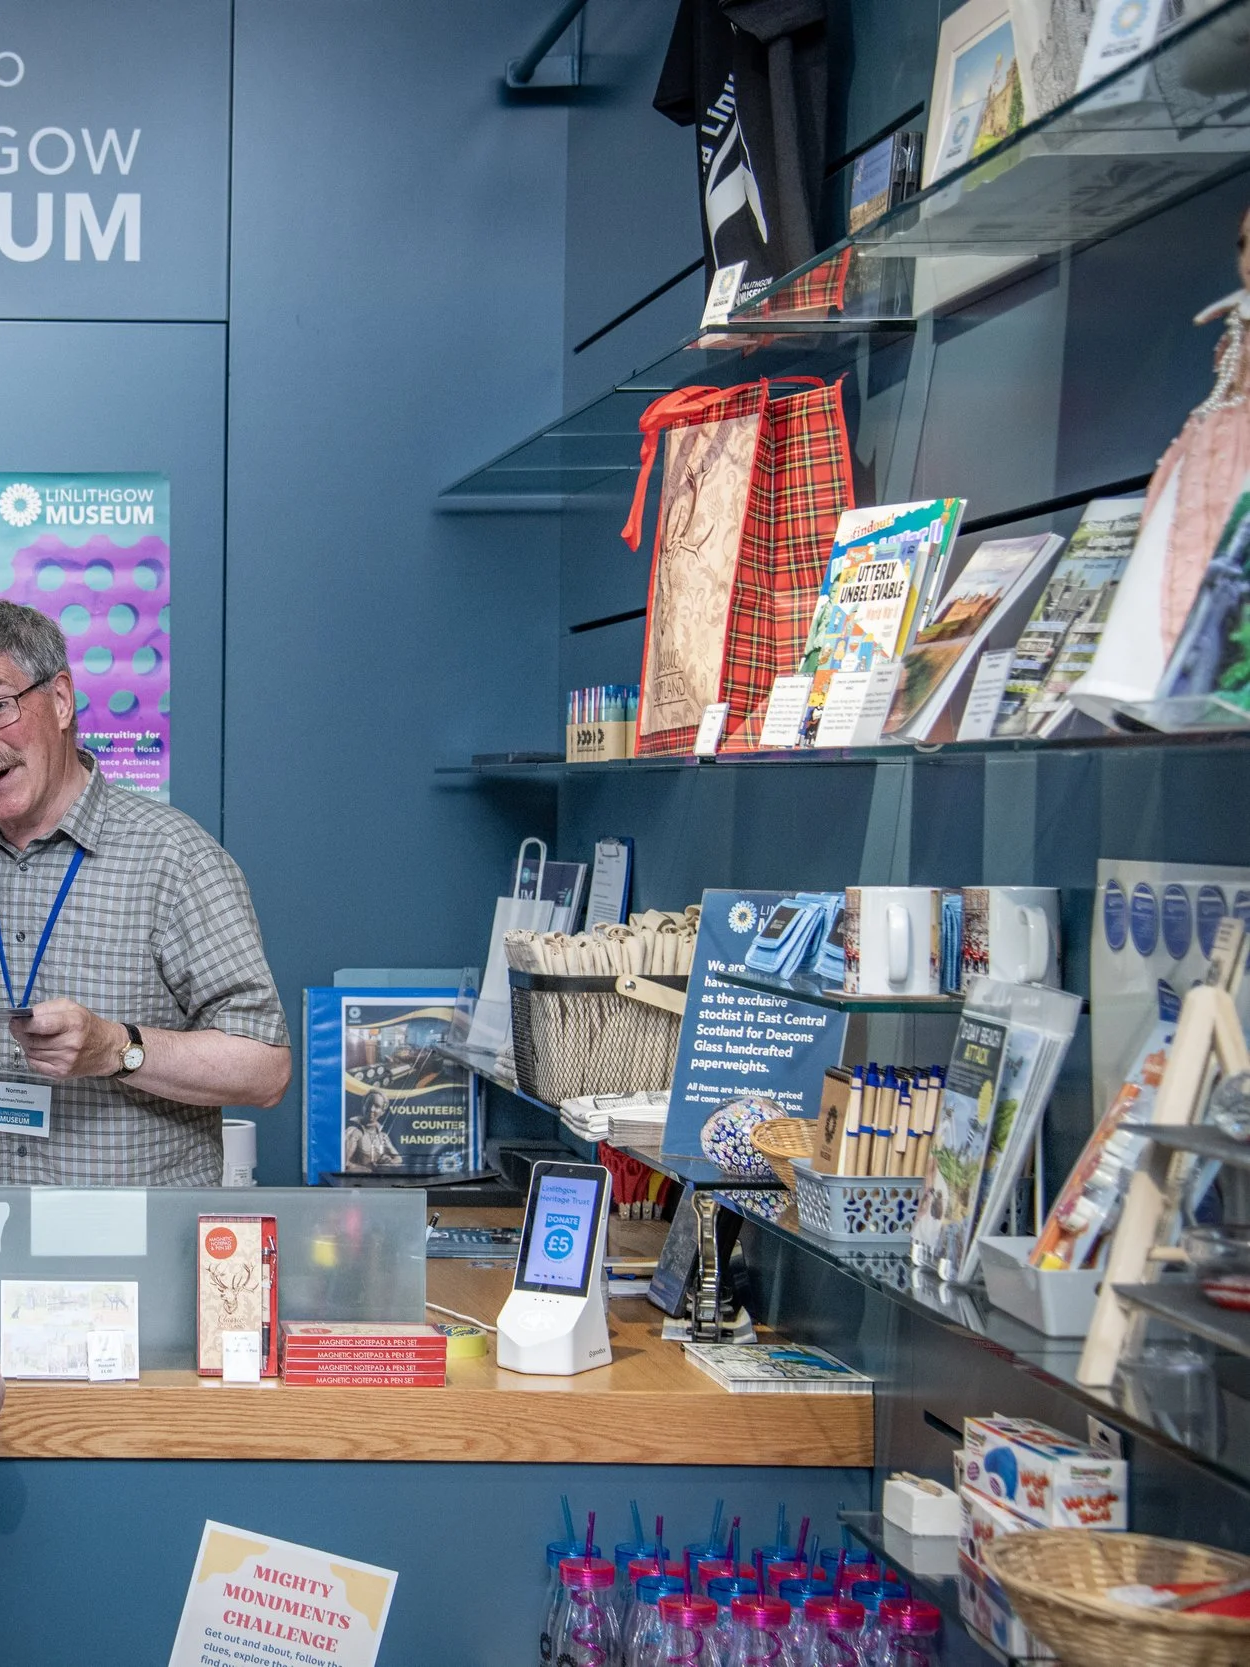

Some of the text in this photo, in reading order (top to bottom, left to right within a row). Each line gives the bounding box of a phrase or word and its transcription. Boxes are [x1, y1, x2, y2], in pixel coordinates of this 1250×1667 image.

[46, 488, 154, 503] LINLITHGOW
[46, 505, 154, 525] MUSEUM
[858, 561, 898, 583] UTTERLY
[840, 581, 904, 603] UNBELIEVABLE
[93, 730, 161, 741] recruiting for
[97, 745, 160, 753] Welcome Hosts
[122, 758, 160, 766] Activities
[126, 771, 160, 779] Sessions
[707, 960, 747, 973] We are
[701, 993, 788, 1008] as the exclusive
[699, 1009, 827, 1027] stockist in East Central
[696, 1024, 814, 1043] Scotland for Deacons
[694, 1040, 793, 1058] Glass handcrafted
[691, 1058, 770, 1074] paperweights.
[5, 1087, 28, 1095] Norman
[686, 1082, 698, 1091] All
[698, 1084, 719, 1093] items
[734, 1087, 777, 1100] individually
[777, 1091, 803, 1101] priced
[685, 1094, 699, 1102] and
[786, 1103, 803, 1112] box.
[0, 1109, 30, 1118] LINLITHGOW
[0, 1115, 30, 1125] MUSEUM
[412, 1120, 466, 1130] COUNTER
[400, 1135, 466, 1145] HANDBOOK
[541, 1184, 578, 1196] Linlithgow
[540, 1195, 571, 1206] Heritage
[547, 1214, 580, 1226] DONATE
[548, 1236, 570, 1252] £5
[218, 1315, 244, 1325] Classic
[318, 1364, 416, 1372] MAGNETIC NOTEPAD & PEN SET
[253, 1564, 334, 1598] MIGHTY
[222, 1583, 352, 1630] MONUMENTS
[223, 1610, 339, 1653] CHALLENGE
[203, 1642, 231, 1658] clues,
[234, 1651, 271, 1667] explore
[204, 1627, 326, 1667] Get out and about, follow
[201, 1654, 221, 1667] find
